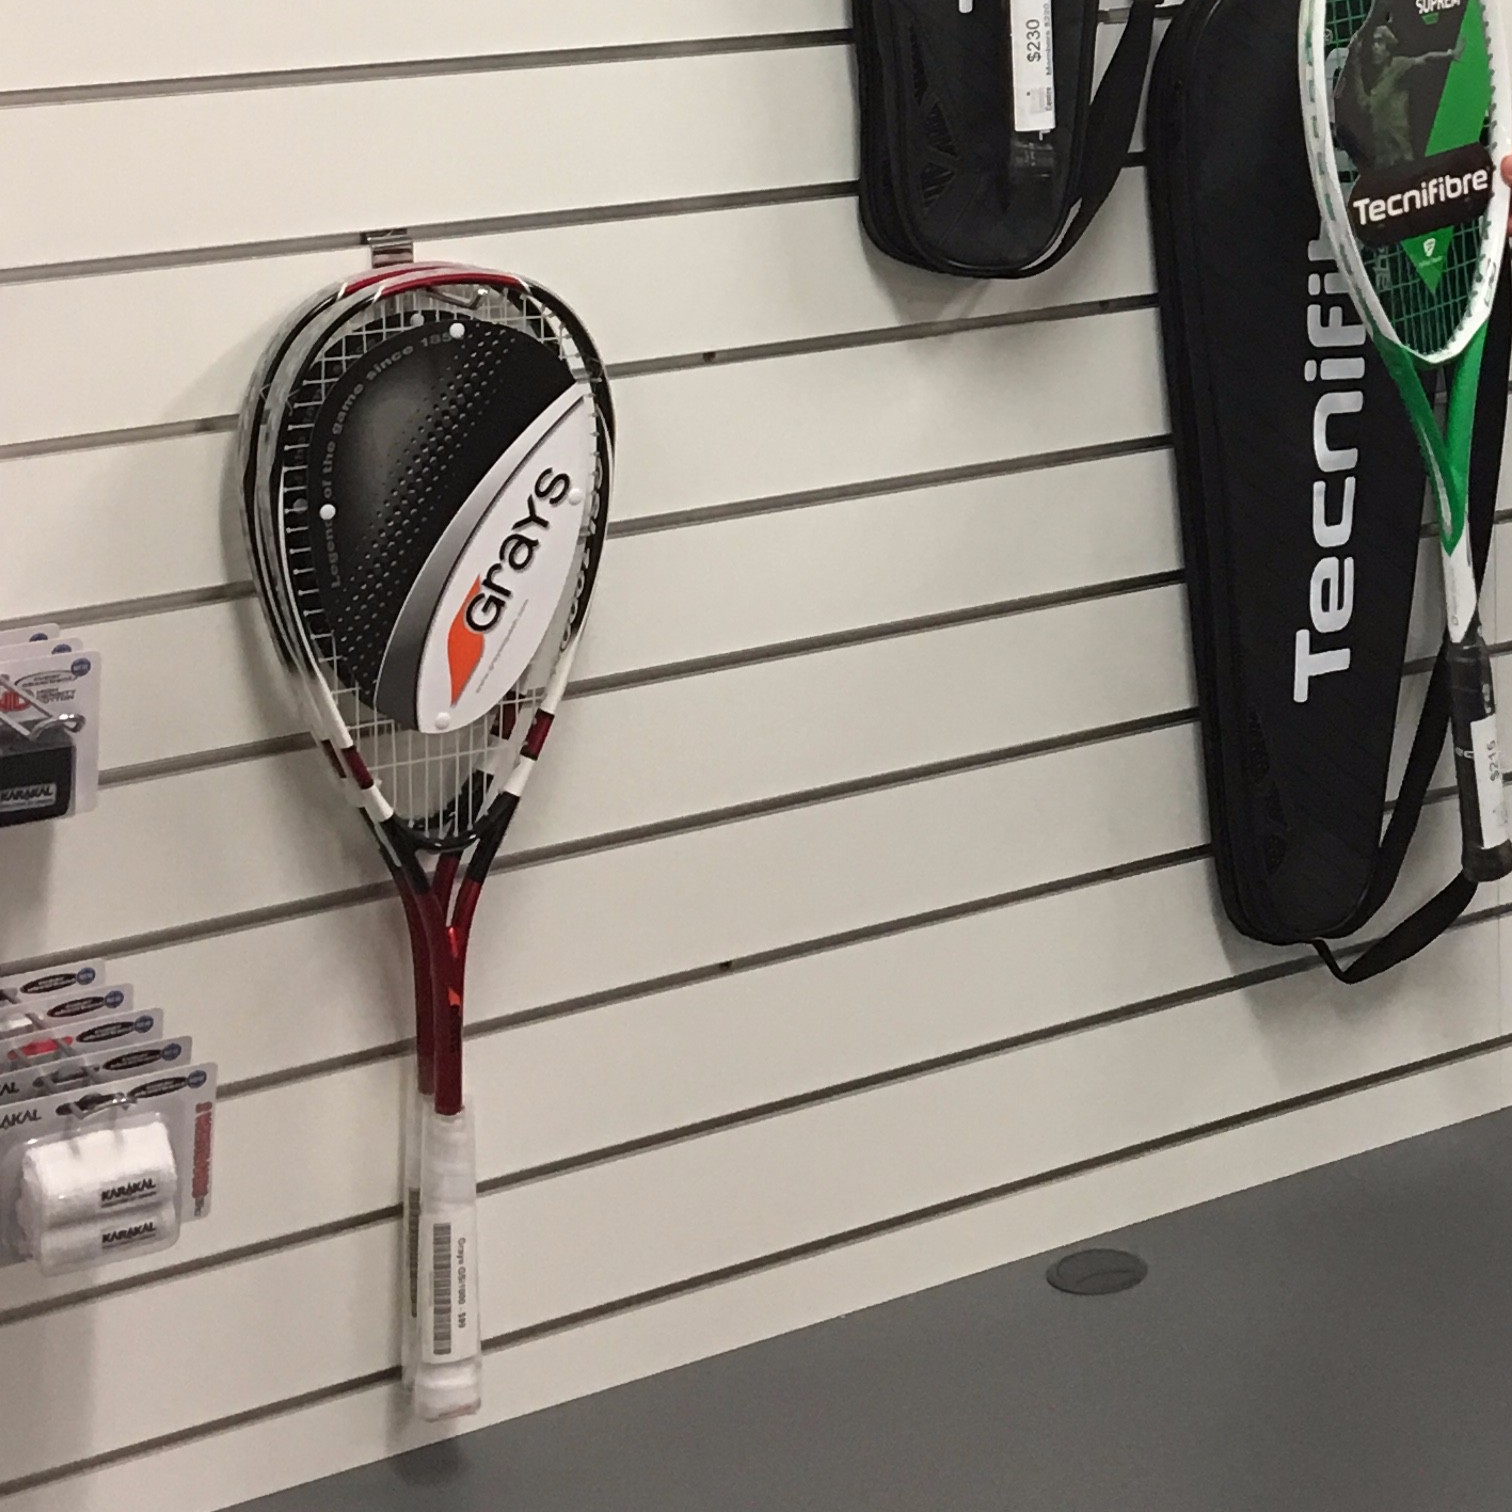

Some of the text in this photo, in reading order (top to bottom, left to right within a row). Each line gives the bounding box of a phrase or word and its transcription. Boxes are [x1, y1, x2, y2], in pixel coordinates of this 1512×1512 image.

[1026, 18, 1041, 63] $230
[1353, 169, 1489, 226] Tecnifibre
[0, 1109, 42, 1129] AKAL
[102, 1178, 157, 1202] KARAKAL
[102, 1222, 157, 1244] KARAKAL
